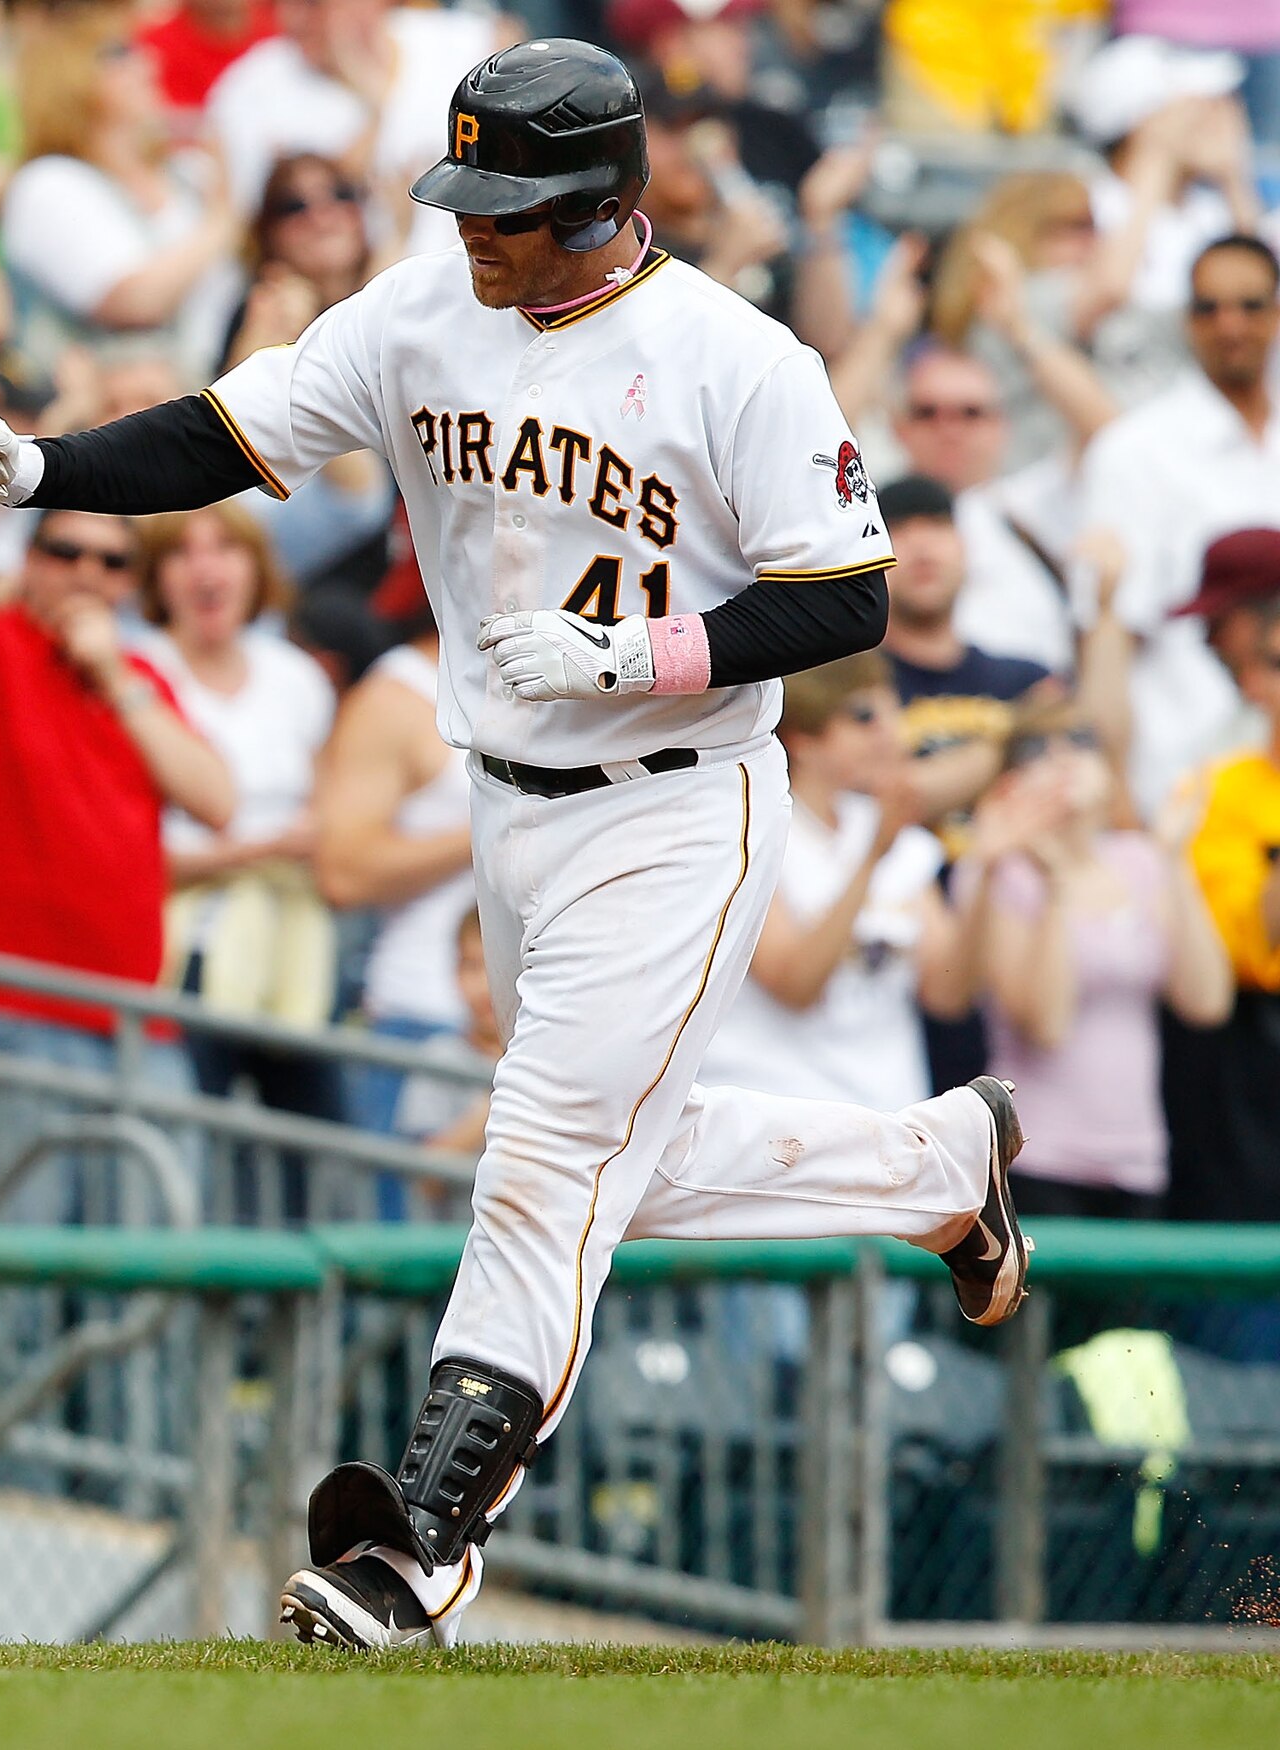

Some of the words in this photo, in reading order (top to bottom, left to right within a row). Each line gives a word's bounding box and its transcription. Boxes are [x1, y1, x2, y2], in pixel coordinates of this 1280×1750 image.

[455, 112, 480, 159] P
[409, 405, 681, 552] PIRATES
[559, 553, 672, 628] 41
